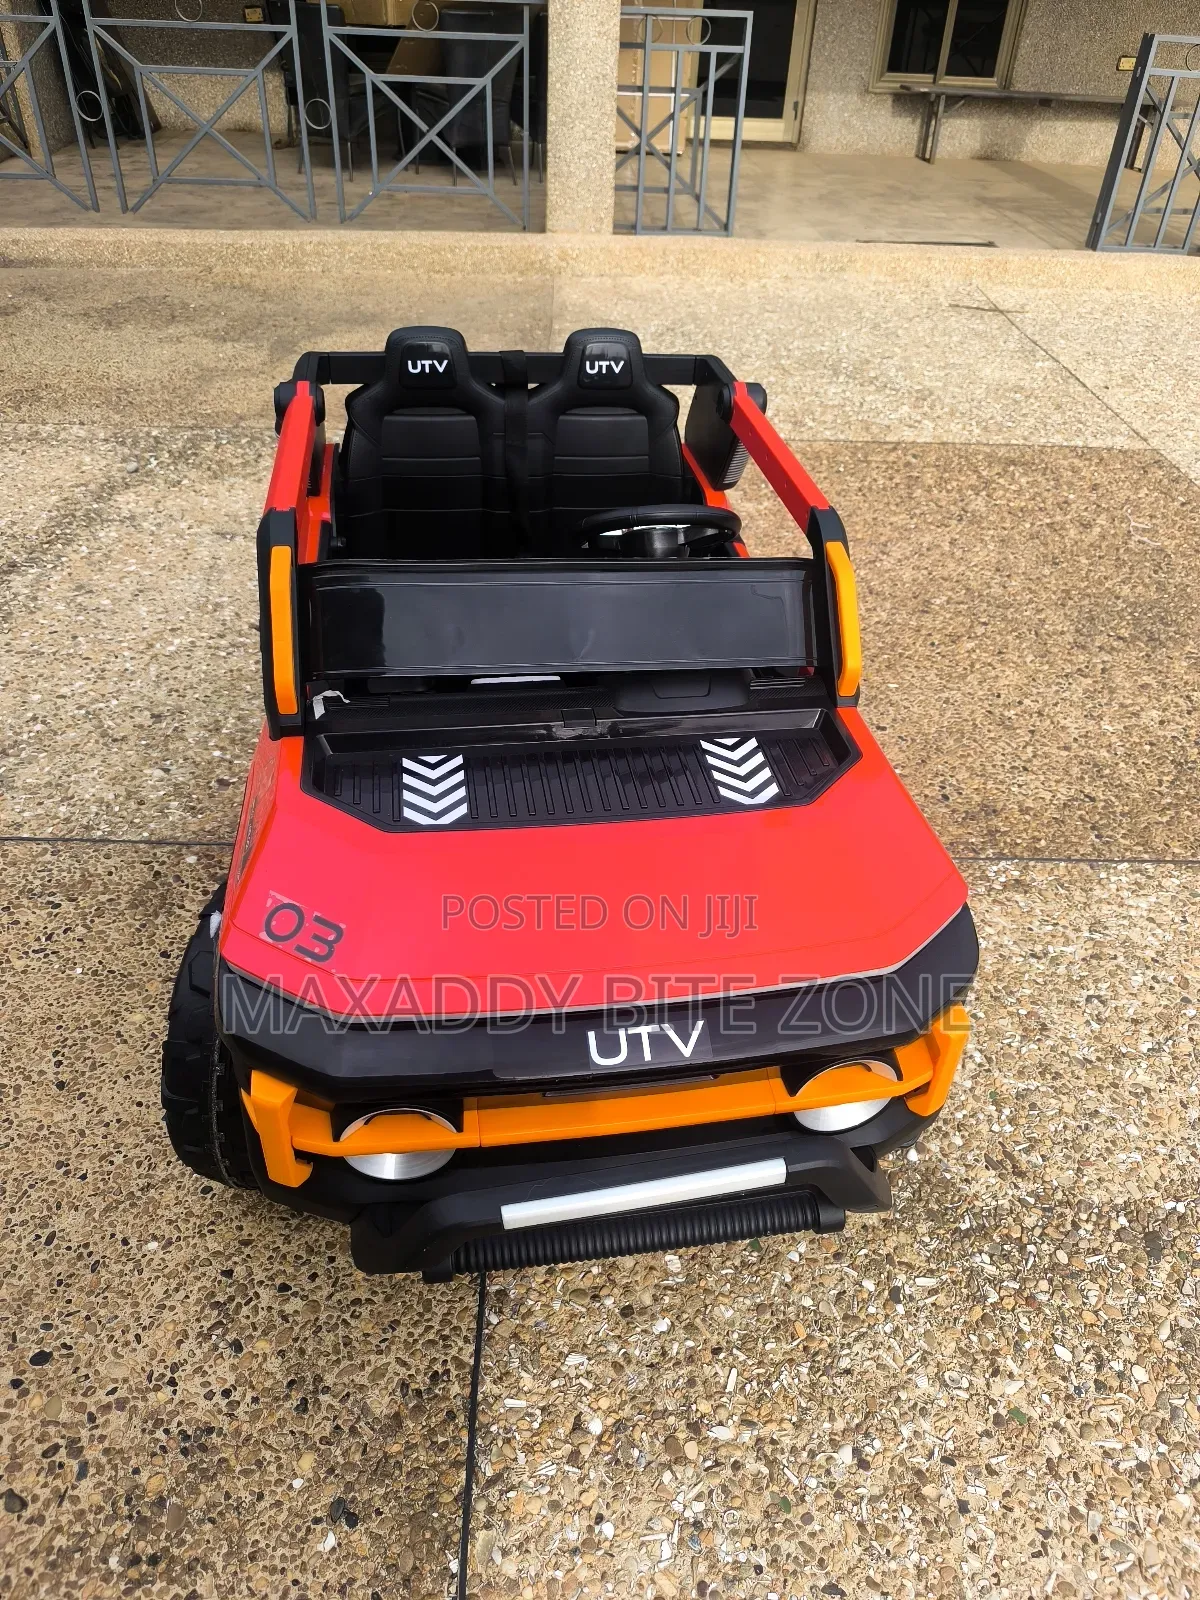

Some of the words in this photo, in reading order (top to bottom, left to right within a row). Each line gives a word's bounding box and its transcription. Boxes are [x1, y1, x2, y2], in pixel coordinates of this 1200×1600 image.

[407, 359, 448, 374] UTV
[585, 360, 624, 374] UTV
[264, 902, 345, 963] 03
[587, 1020, 705, 1067] UTV
